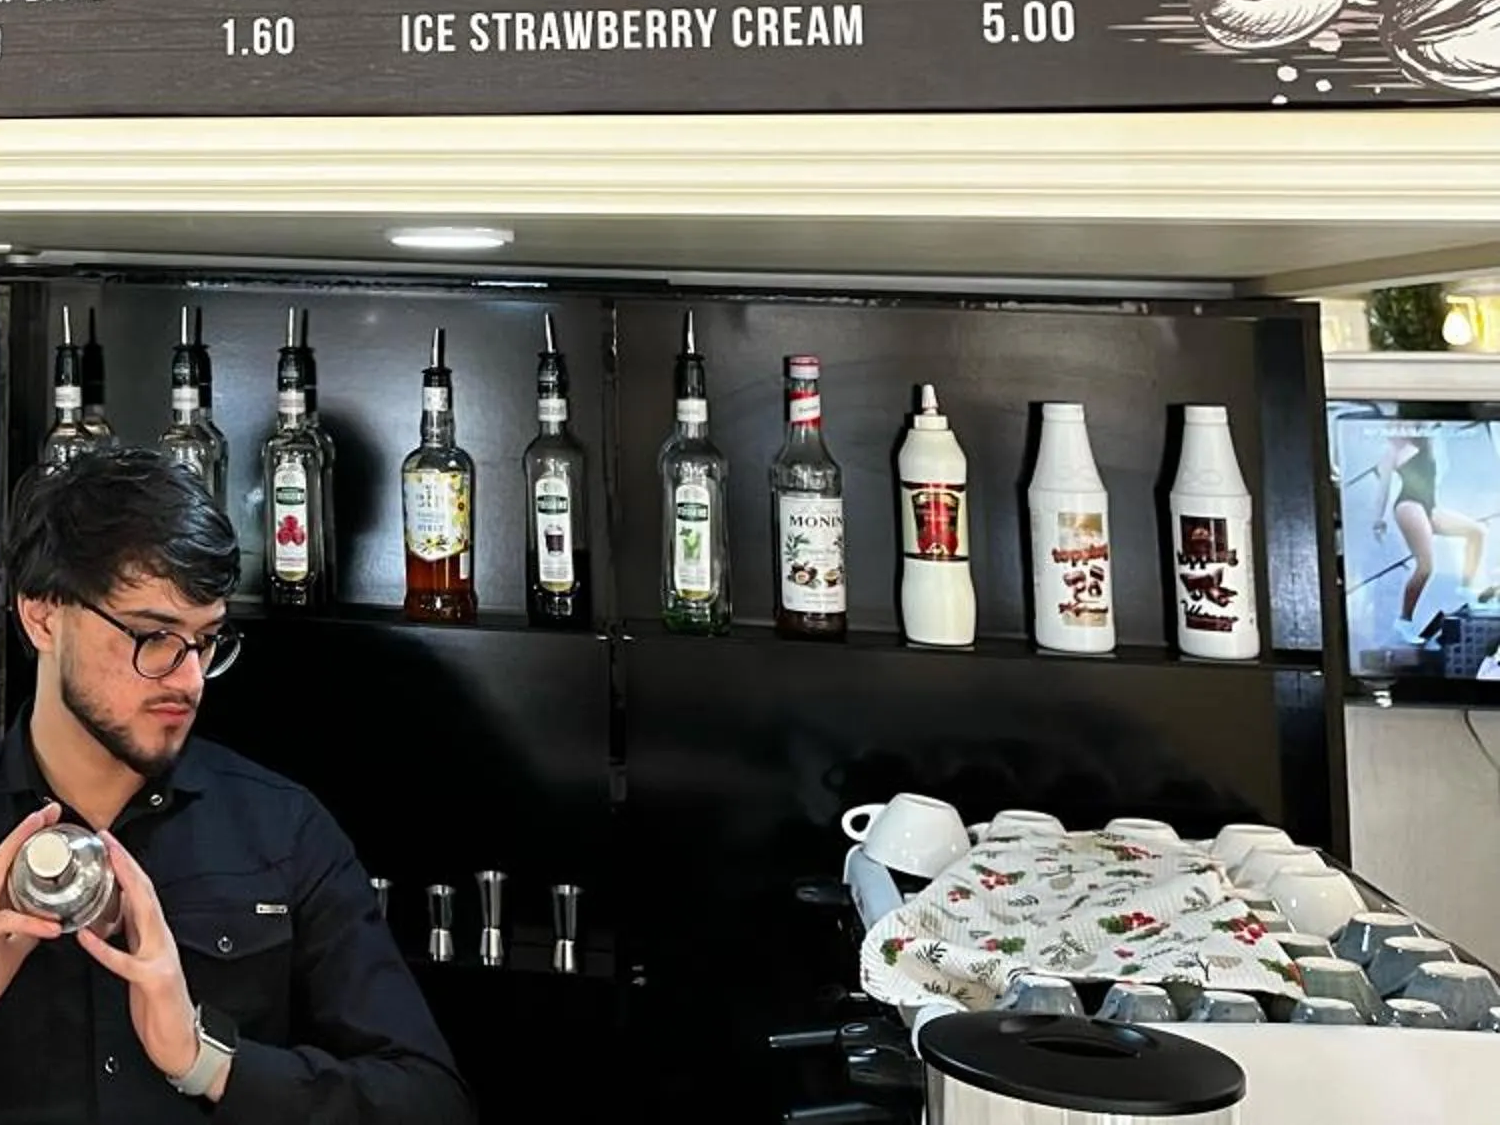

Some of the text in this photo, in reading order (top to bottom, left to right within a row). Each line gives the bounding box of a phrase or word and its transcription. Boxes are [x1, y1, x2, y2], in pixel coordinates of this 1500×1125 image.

[222, 16, 295, 56] 1.60
[401, 4, 863, 53] ICE STRAWBERRY CREAM
[983, 0, 1075, 44] 5.00
